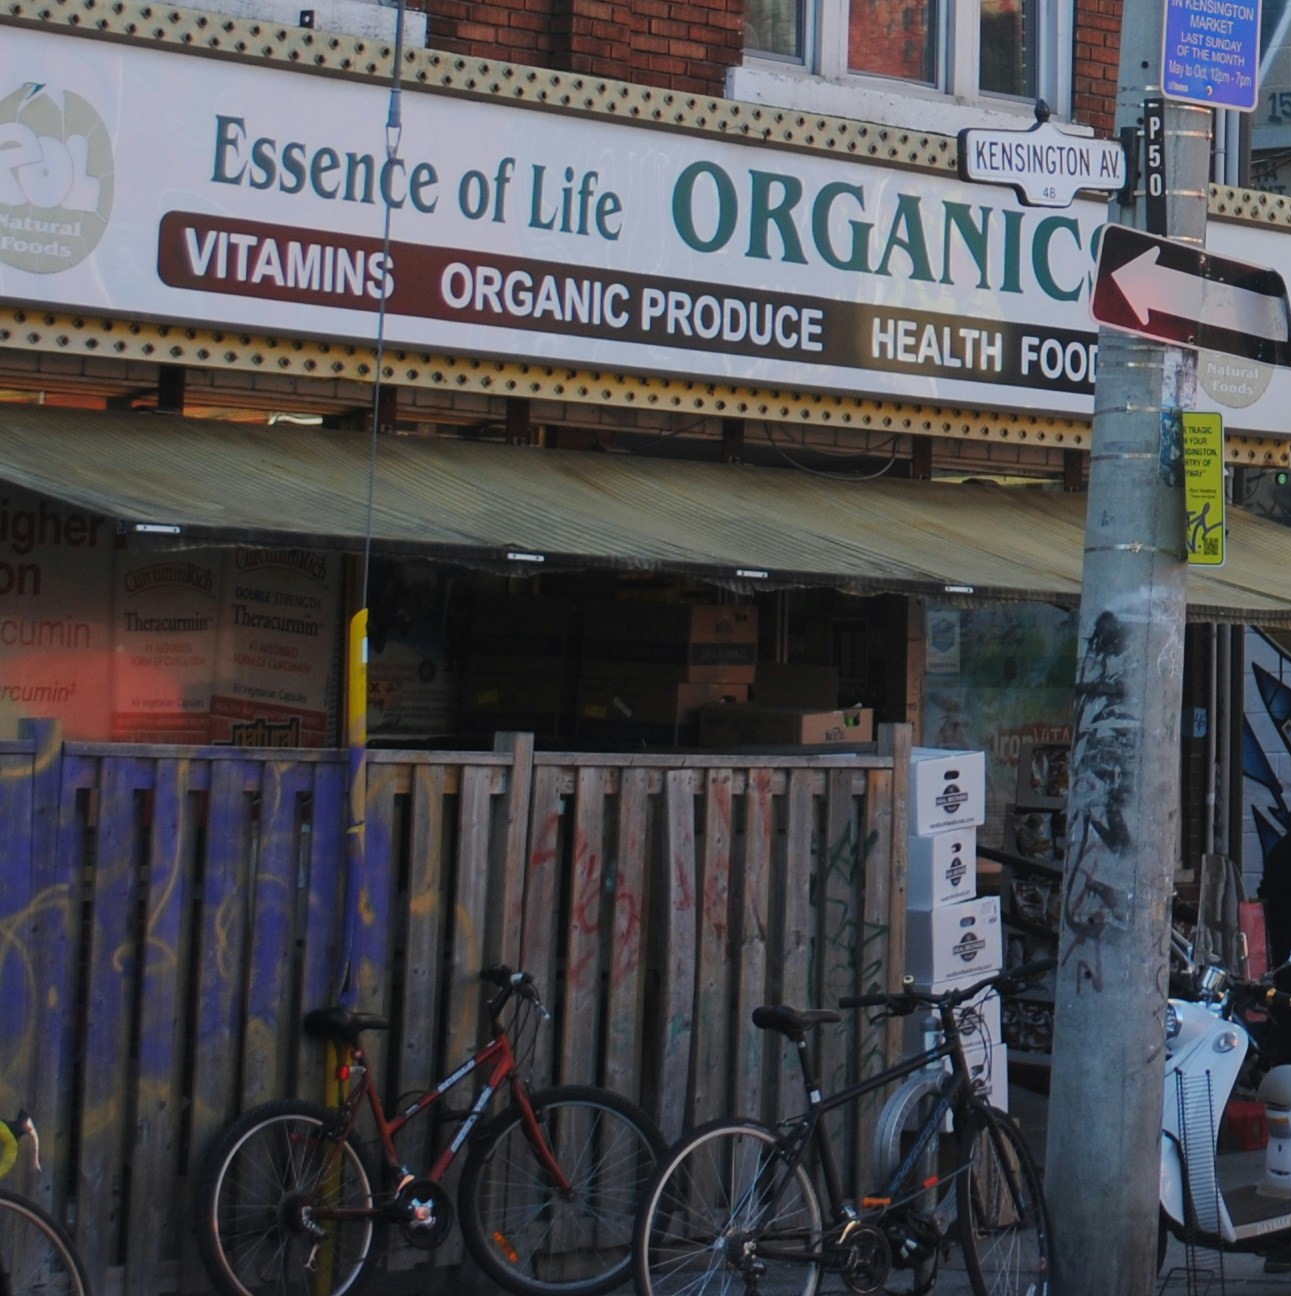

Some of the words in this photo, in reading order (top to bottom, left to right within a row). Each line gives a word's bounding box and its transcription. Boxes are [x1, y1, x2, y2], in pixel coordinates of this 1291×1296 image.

[1190, 14, 1234, 34] MARKET
[1181, 31, 1204, 46] LAST
[1205, 35, 1243, 52] SUNDAY
[1177, 44, 1190, 56] OF
[1191, 47, 1210, 61] THE
[1211, 51, 1245, 67] MONTH
[976, 140, 1091, 177] KENSINGTON
[1099, 150, 1120, 179] AV.
[211, 114, 440, 214] Essence
[458, 156, 516, 223] of
[529, 163, 624, 242] Life
[1043, 187, 1056, 199] 48
[1, 236, 72, 257] Foods
[185, 226, 395, 300] VITAMINS
[440, 261, 630, 328] ORGANIC
[640, 286, 825, 353] PRODUCE
[871, 315, 1003, 372] HEALTH
[1207, 362, 1259, 380] Natural
[1212, 380, 1254, 395] Foods
[0, 614, 91, 648] cumin
